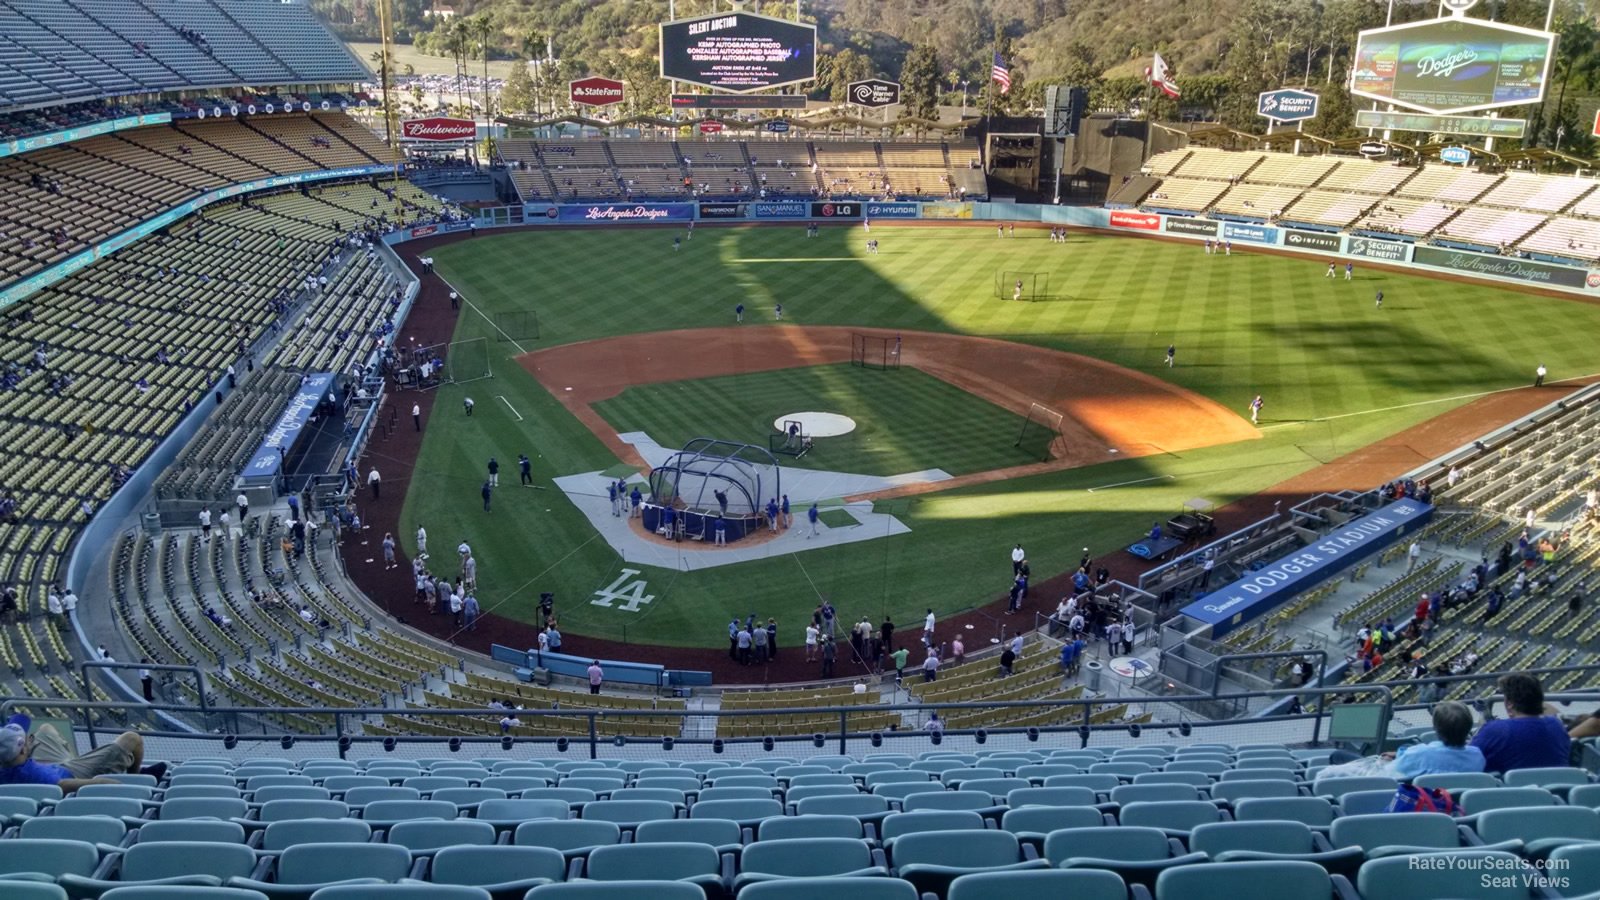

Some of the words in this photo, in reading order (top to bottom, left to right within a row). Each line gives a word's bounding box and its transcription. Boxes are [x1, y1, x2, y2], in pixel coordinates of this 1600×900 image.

[688, 21, 710, 35] SILENT
[711, 16, 737, 31] AUCTION
[1416, 50, 1478, 77] Dodgers
[1280, 97, 1313, 105] SECURITY
[406, 123, 474, 135] Budweiser
[273, 177, 289, 185] Donate
[585, 207, 600, 219] Los
[600, 206, 634, 220] Angeles
[633, 206, 668, 220] Dodgers
[837, 204, 851, 215] LG
[1303, 238, 1337, 246] INFINITI
[1368, 240, 1404, 252] SECURITY
[1366, 249, 1398, 258] BENEFIT
[1446, 254, 1463, 268] Los
[1464, 257, 1505, 273] Angeles
[1505, 262, 1551, 280] Dodgers
[1241, 554, 1324, 594] DODGER
[1318, 517, 1394, 555] STADIUM
[590, 568, 655, 612] LA
